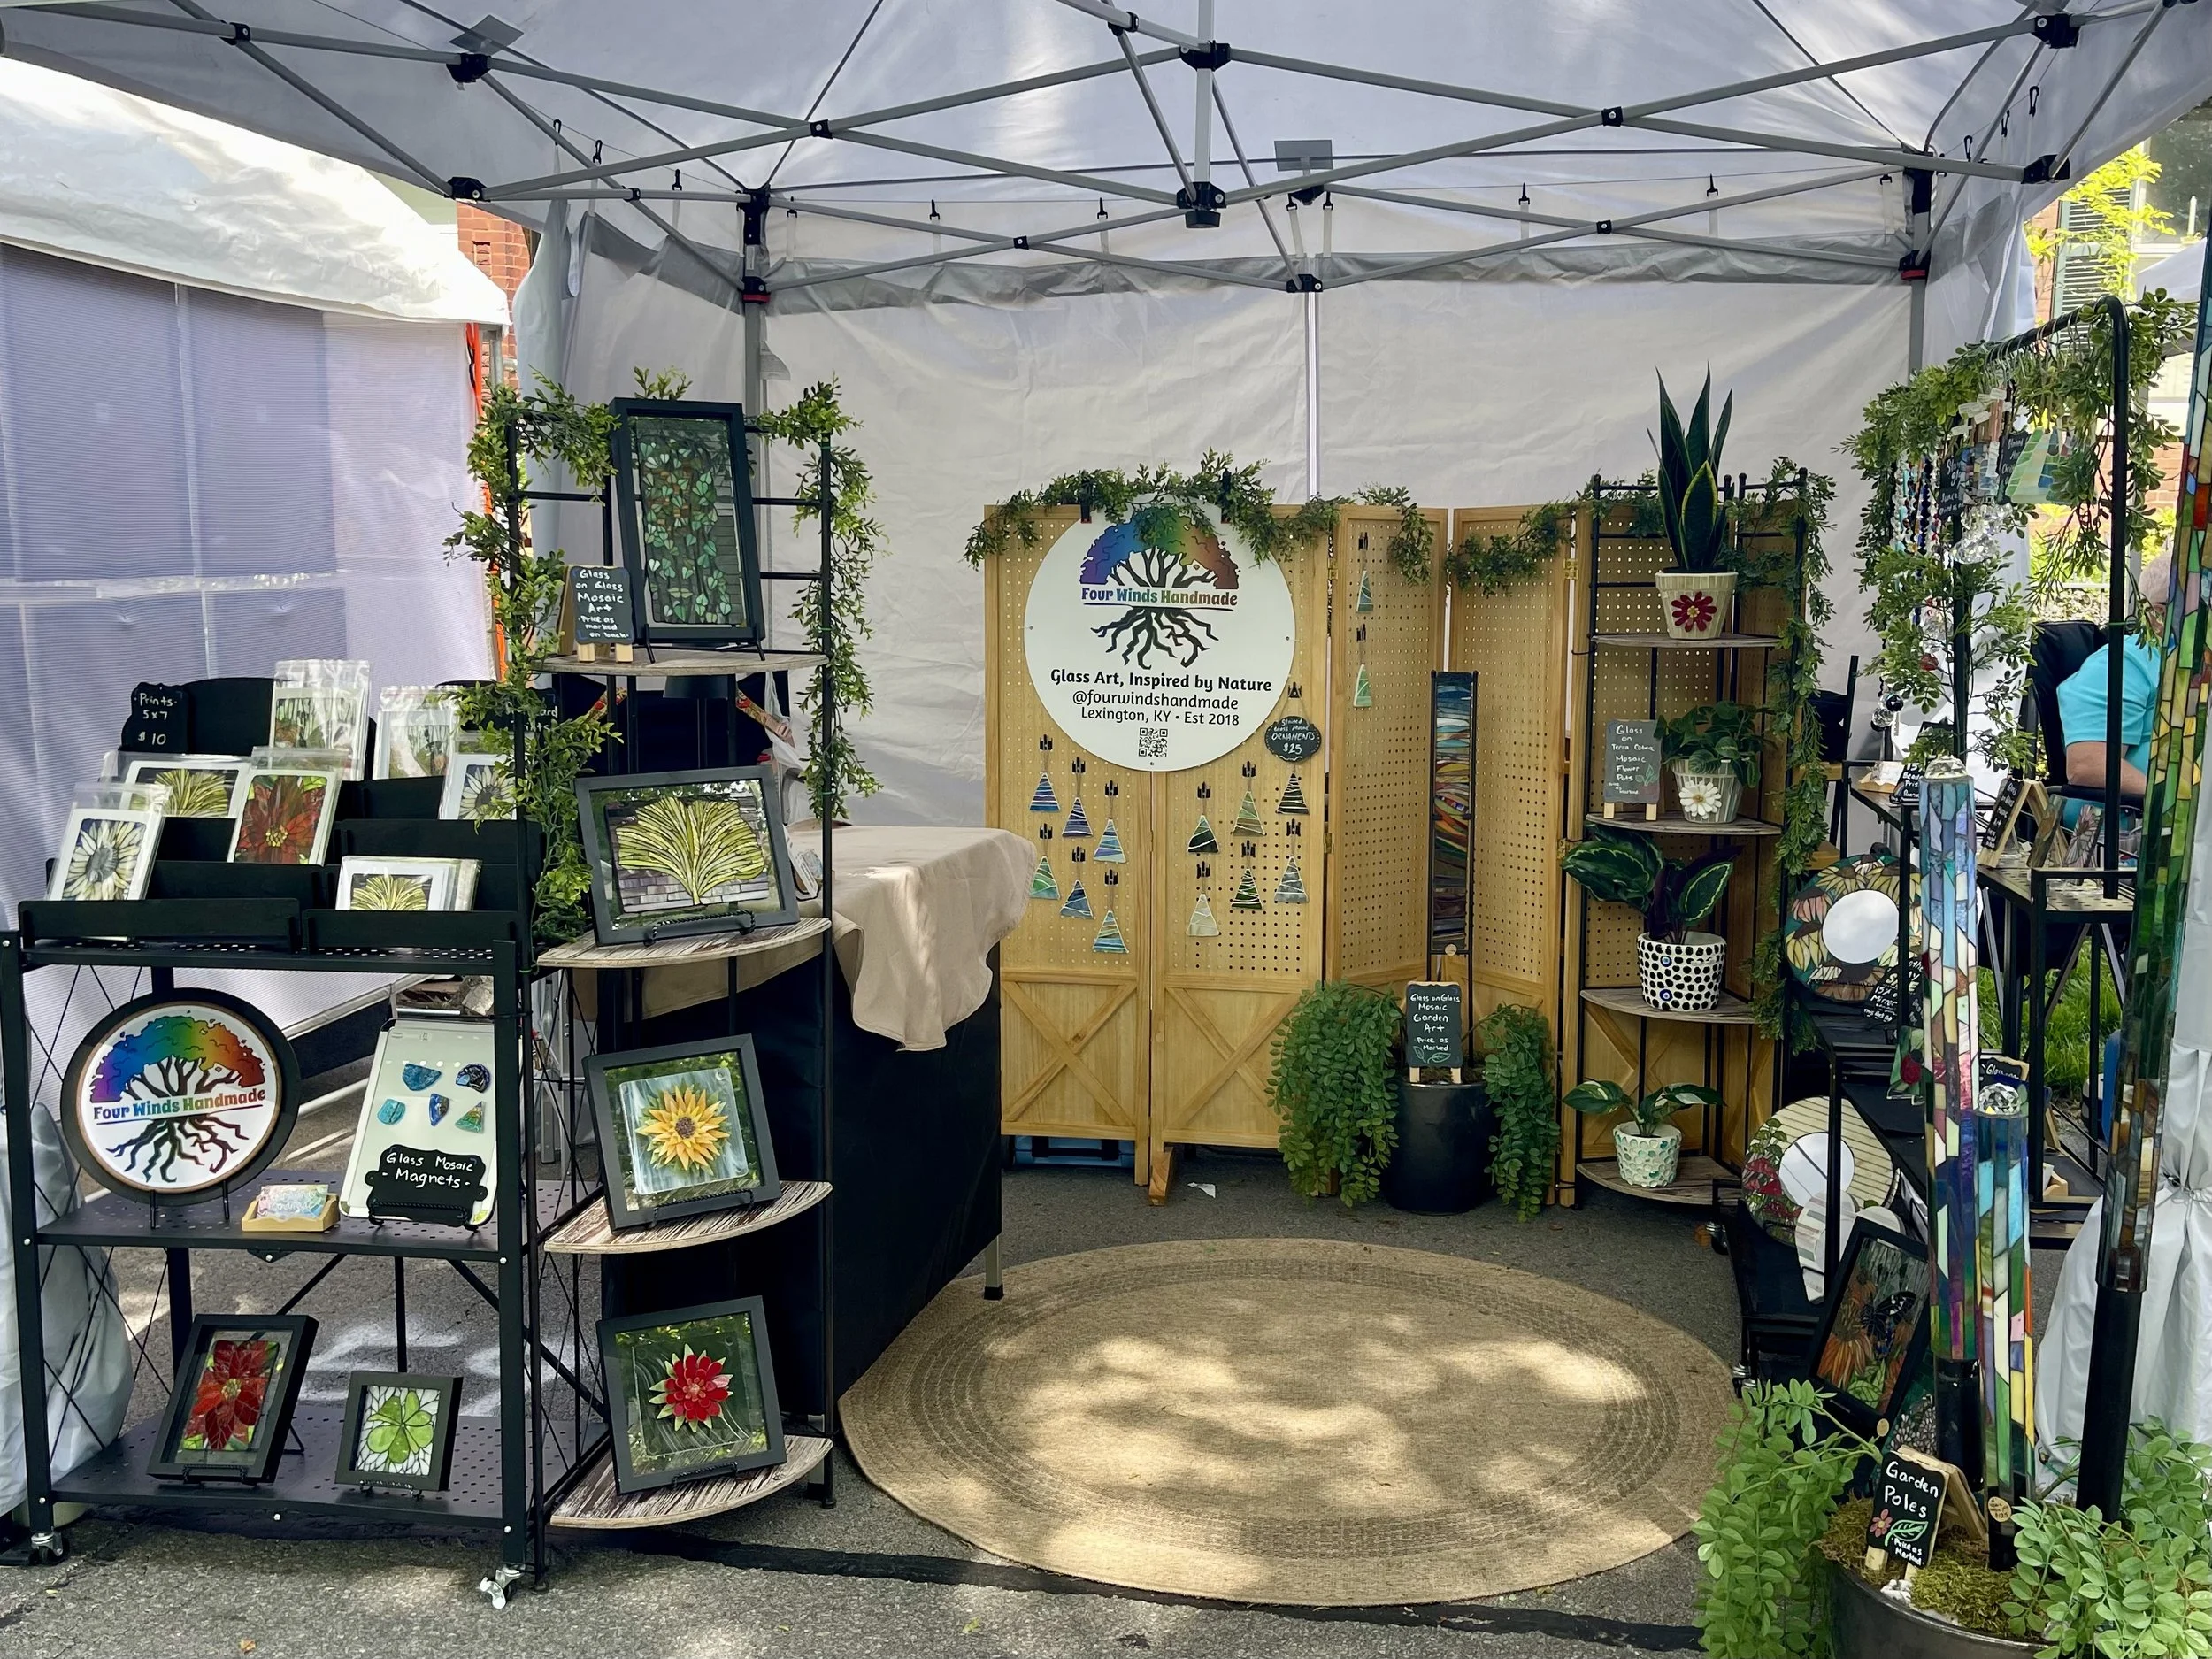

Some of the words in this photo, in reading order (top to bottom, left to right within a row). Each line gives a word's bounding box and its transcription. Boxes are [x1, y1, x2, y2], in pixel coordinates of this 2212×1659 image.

[580, 569, 610, 580] Glass
[595, 581, 623, 592] Glass
[577, 592, 624, 603] Mosaic
[1081, 588, 1113, 601] Four
[1116, 588, 1158, 603] Winds
[1161, 590, 1238, 606] Handmade
[588, 603, 613, 613] Art
[1050, 669, 1090, 685] Glass
[1094, 672, 1124, 687] Art,
[1129, 672, 1189, 689] Inspired
[1195, 675, 1213, 692] by
[1218, 677, 1271, 691] Nature
[140, 693, 173, 706] Prints
[1073, 690, 1239, 709] @fourwindshandmade
[1081, 707, 1148, 723] Lexington,
[1154, 710, 1171, 722] KY
[1184, 711, 1204, 724] Est
[1209, 713, 1240, 726] 2018
[1616, 725, 1643, 734] Glass
[1271, 732, 1316, 741] ORNAMENTS
[1283, 743, 1302, 754] $25
[1440, 994, 1460, 1002] Glass
[1413, 1013, 1448, 1022] Garden
[1424, 1023, 1445, 1033] Art
[94, 1106, 130, 1119] Four
[133, 1100, 180, 1116] Winds
[182, 1088, 265, 1111] Handmade
[386, 1152, 424, 1166] Glass
[435, 1156, 473, 1171] Mosaic
[395, 1167, 460, 1188] Magnets
[1886, 1461, 1938, 1498] Garden
[1885, 1485, 1927, 1518] Poles
[1912, 1546, 1922, 1555] as
